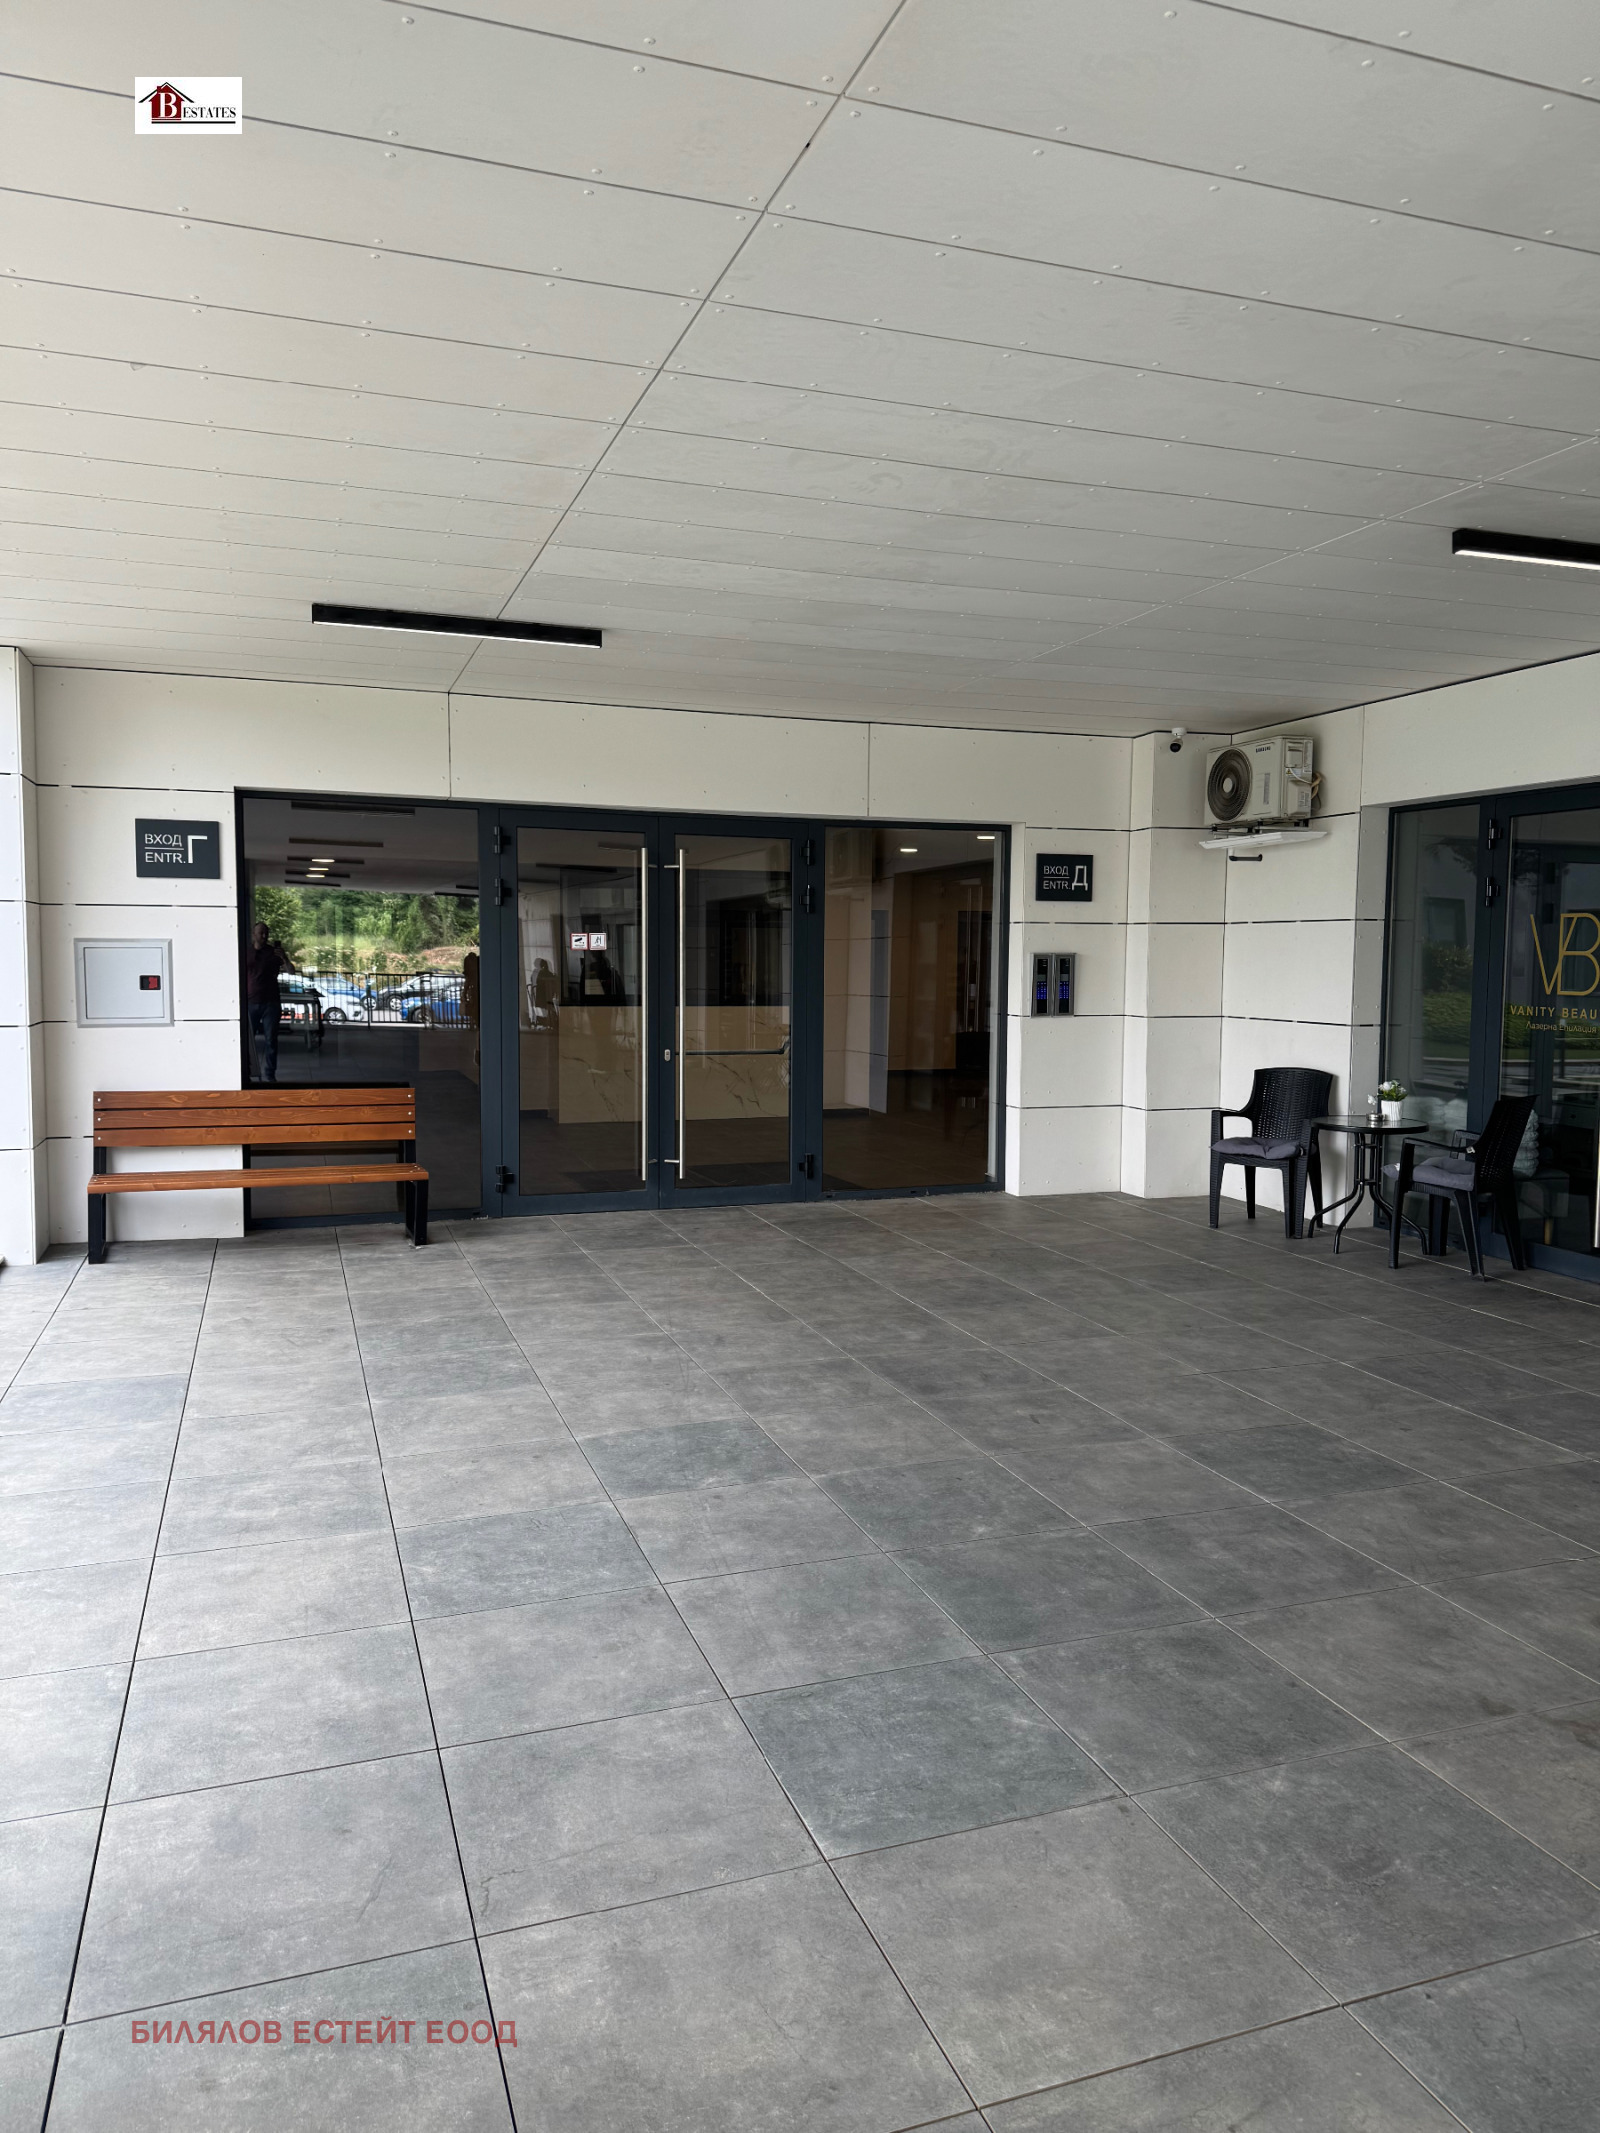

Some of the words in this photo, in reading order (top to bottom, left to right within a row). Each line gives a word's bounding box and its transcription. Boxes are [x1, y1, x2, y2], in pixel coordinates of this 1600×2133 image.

[144, 833, 183, 847] ВХОД
[187, 834, 208, 864] Г
[145, 851, 186, 864] ENTR.
[1043, 865, 1069, 876] ВХОД
[1072, 865, 1088, 891] Д
[1043, 880, 1071, 890] ENTR.
[1510, 1005, 1555, 1017] VANITY
[1525, 1020, 1557, 1031] Лазерна
